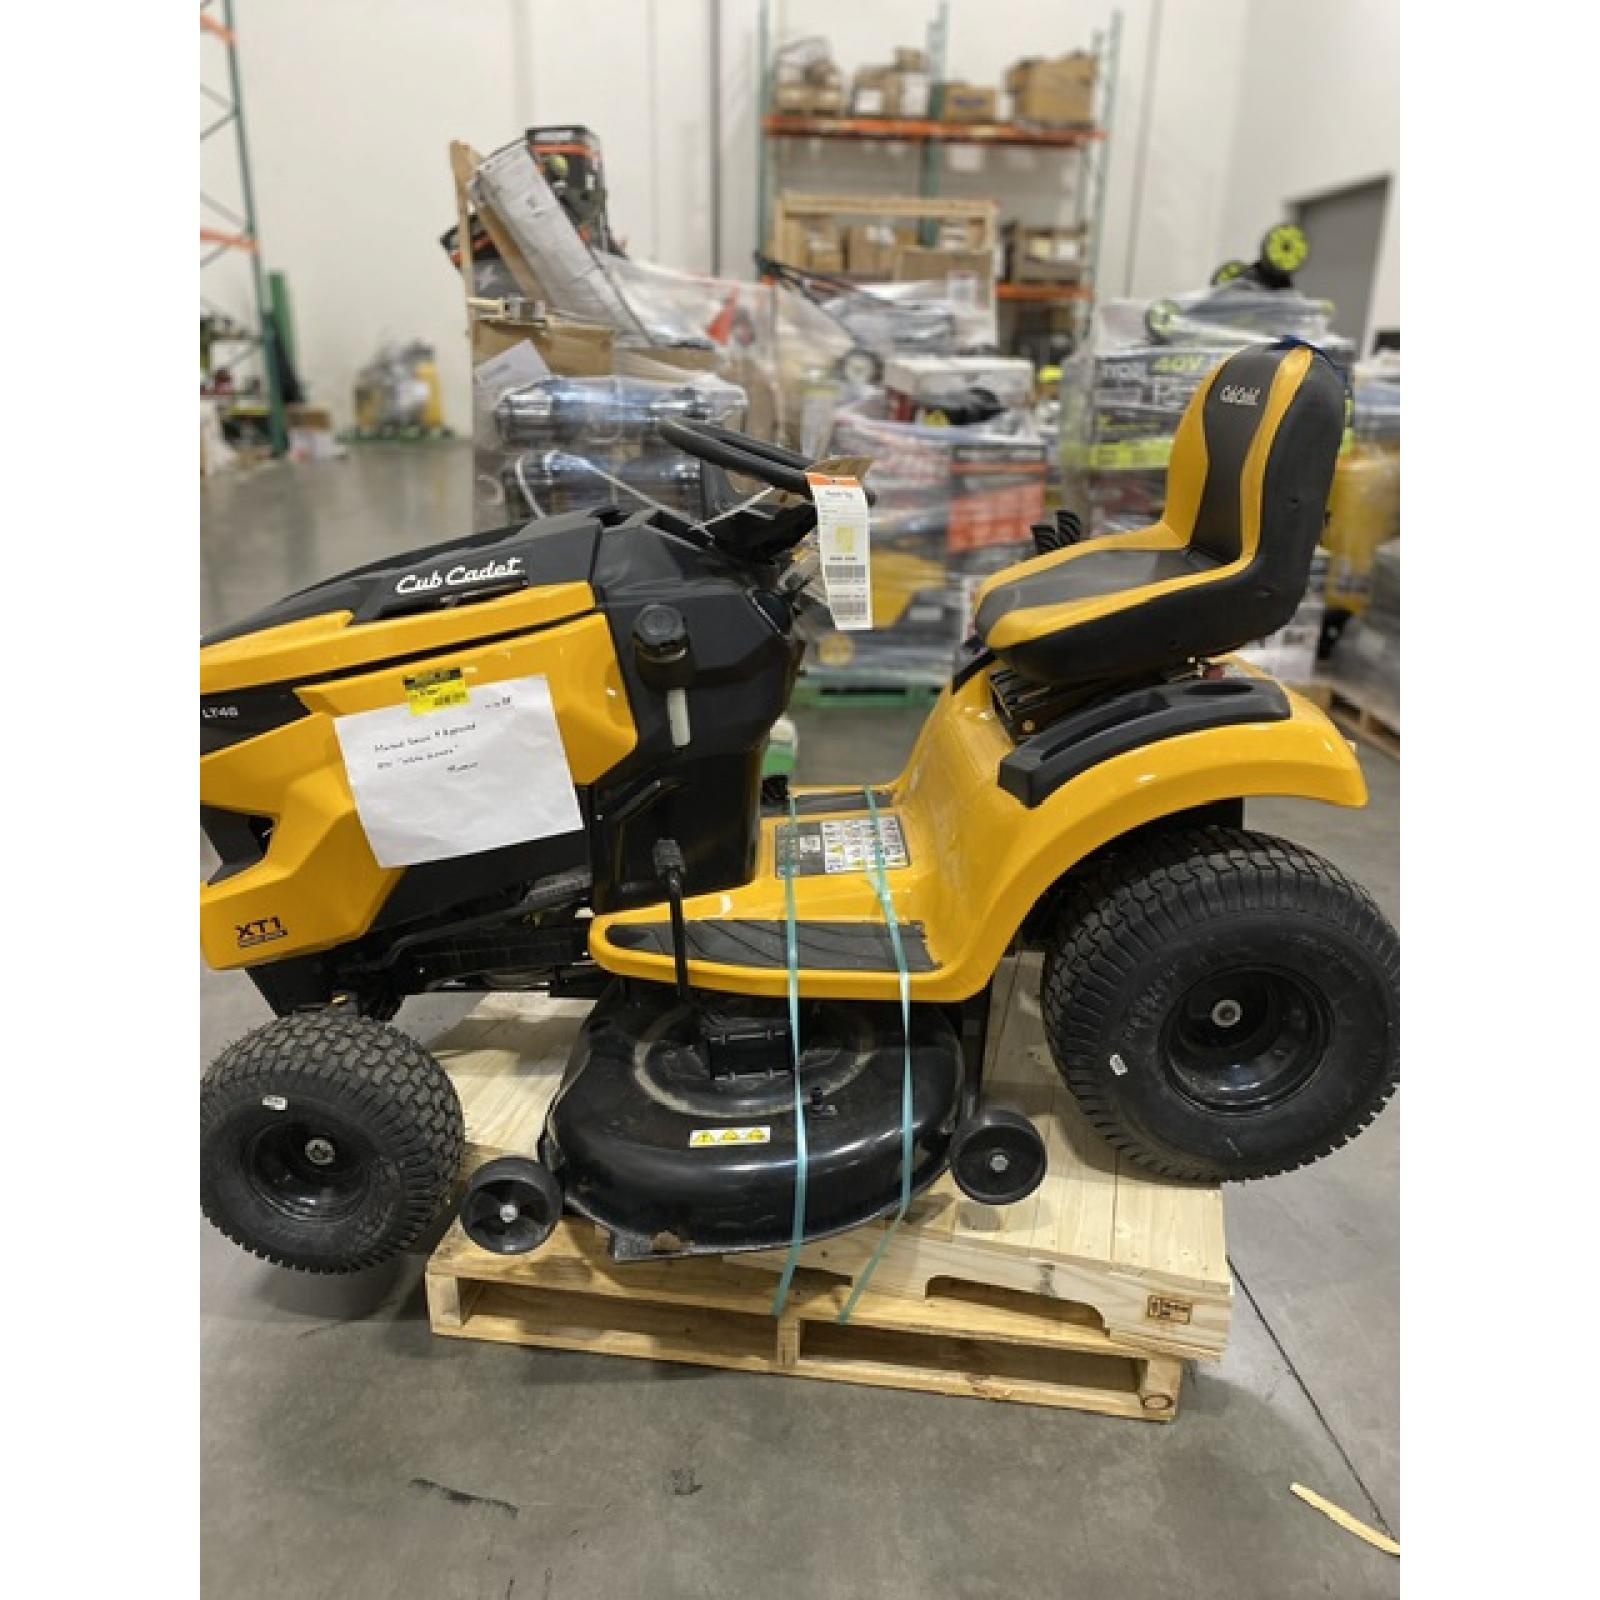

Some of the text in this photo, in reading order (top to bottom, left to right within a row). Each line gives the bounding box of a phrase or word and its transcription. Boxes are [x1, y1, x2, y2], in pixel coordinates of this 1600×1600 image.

[395, 557, 525, 593] Cub Cadet
[234, 916, 281, 937] XT1
